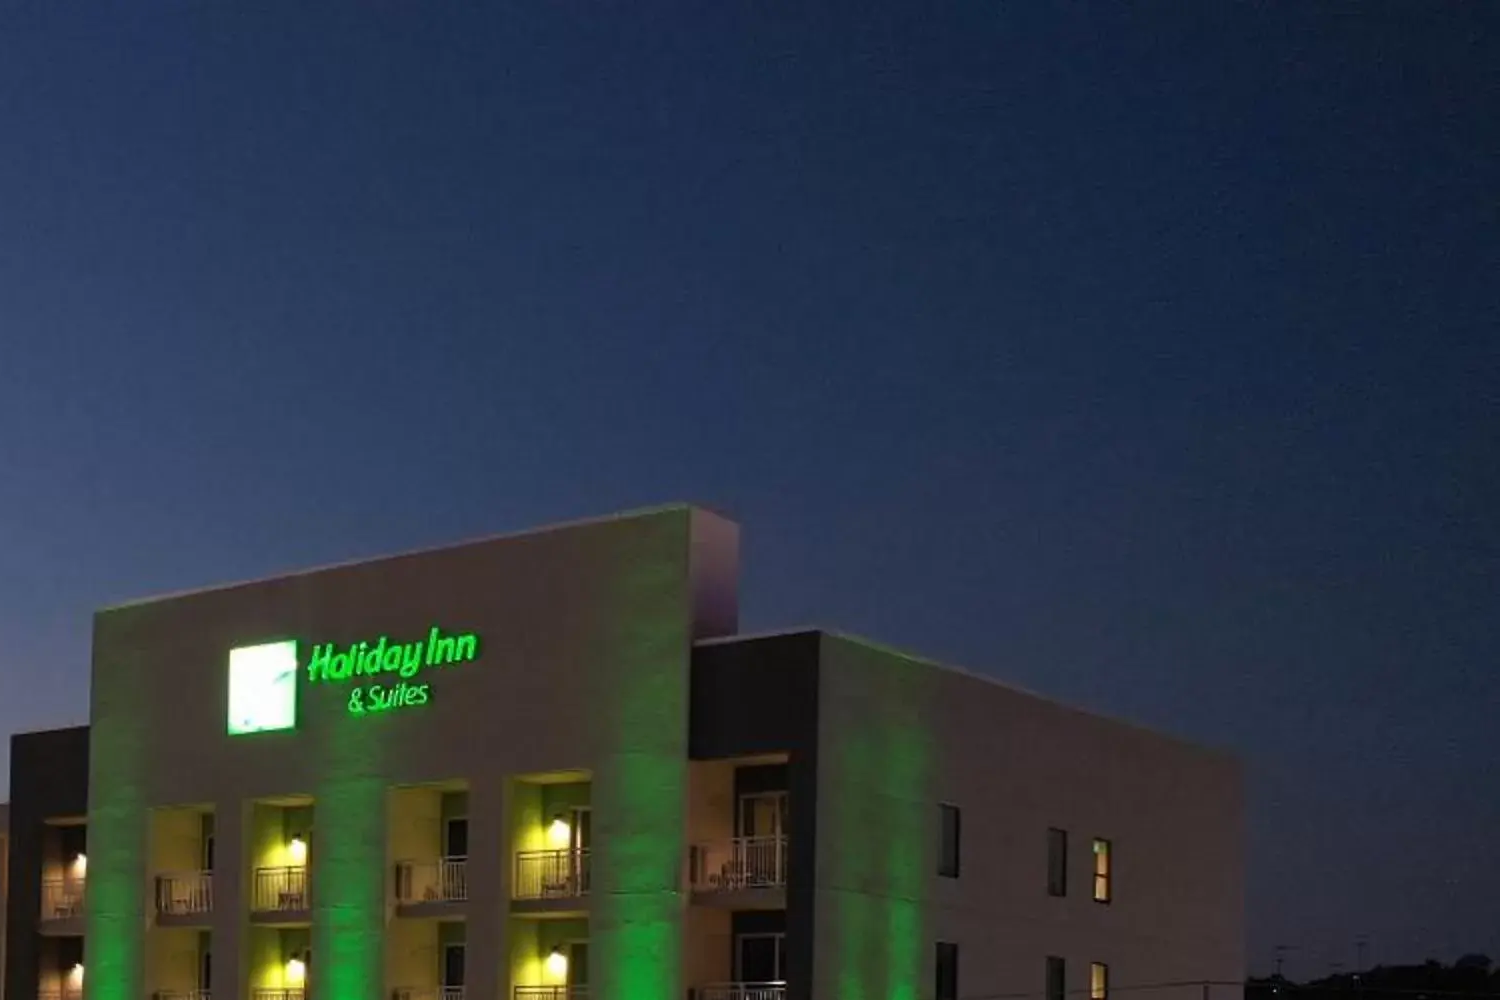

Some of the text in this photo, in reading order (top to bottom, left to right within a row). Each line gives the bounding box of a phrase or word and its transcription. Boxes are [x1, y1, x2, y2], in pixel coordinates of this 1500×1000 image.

[307, 627, 477, 680] Holiday Inn
[348, 684, 429, 712] & Suites
